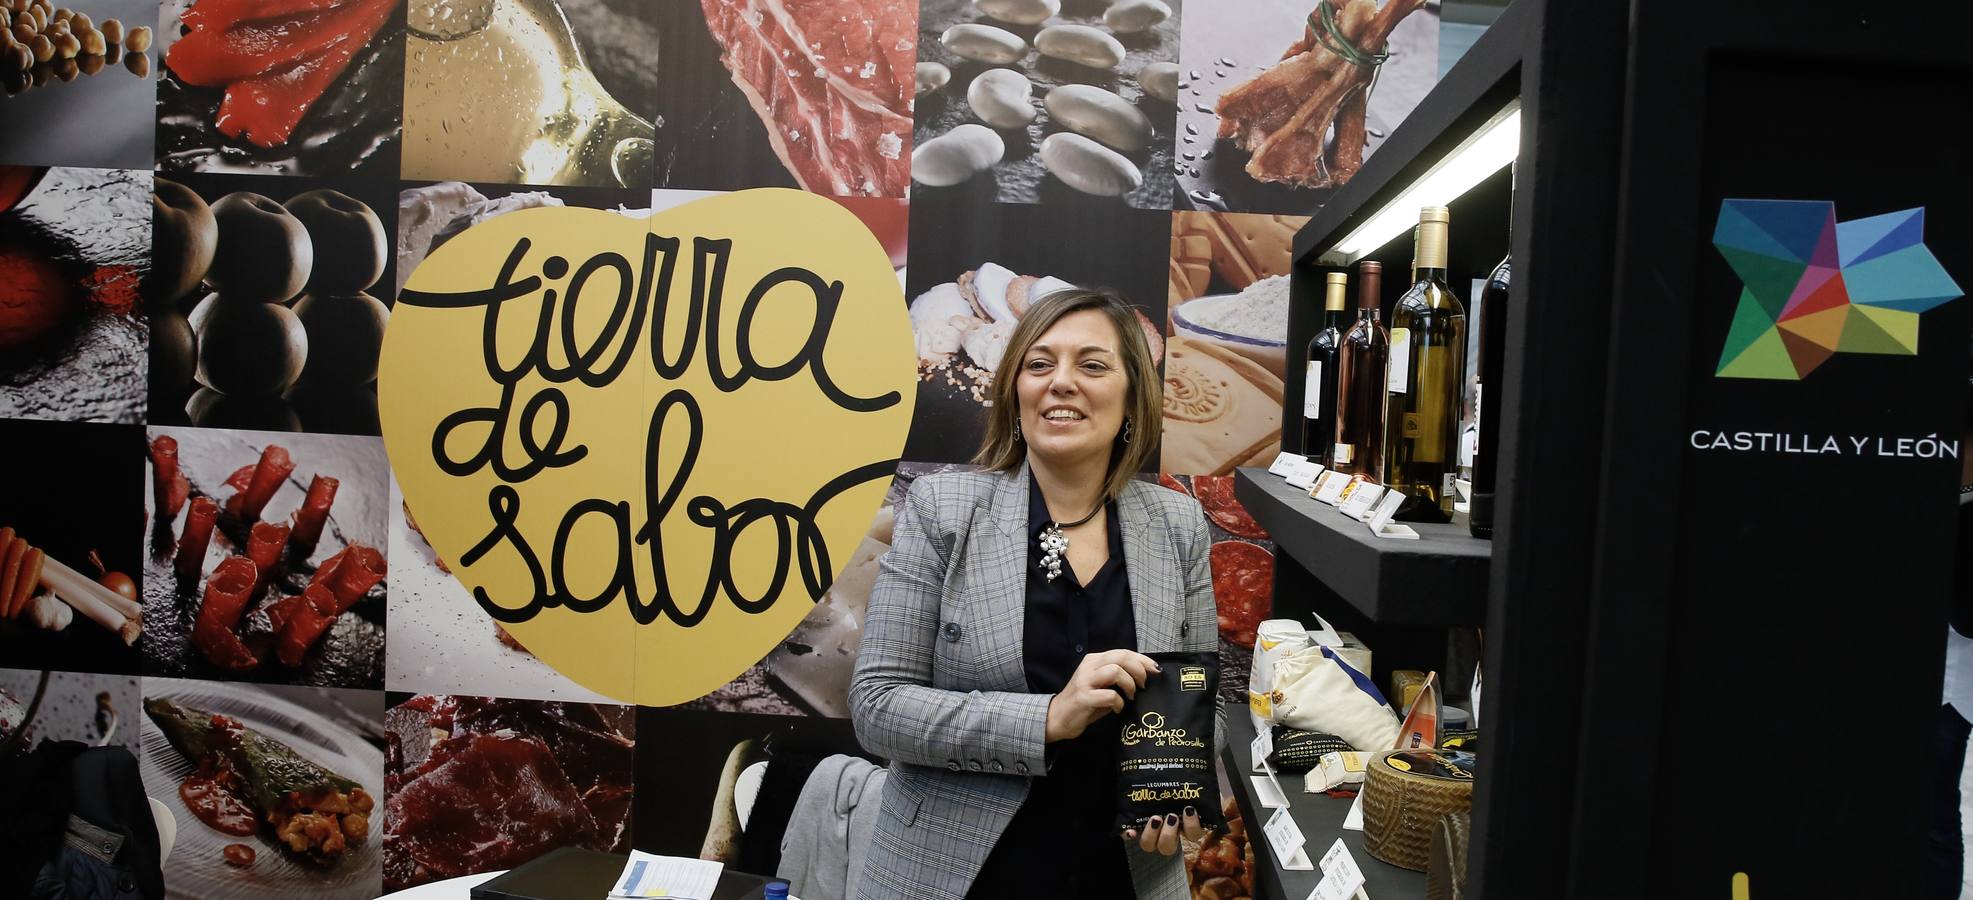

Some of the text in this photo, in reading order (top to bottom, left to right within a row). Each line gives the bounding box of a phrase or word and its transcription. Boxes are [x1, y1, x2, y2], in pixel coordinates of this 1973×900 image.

[397, 232, 901, 412] tierra
[432, 379, 588, 483] de
[1690, 430, 1958, 458] CASTILLA Y LEÓN
[460, 389, 901, 628] sabor
[1125, 723, 1186, 740] Garbanzo
